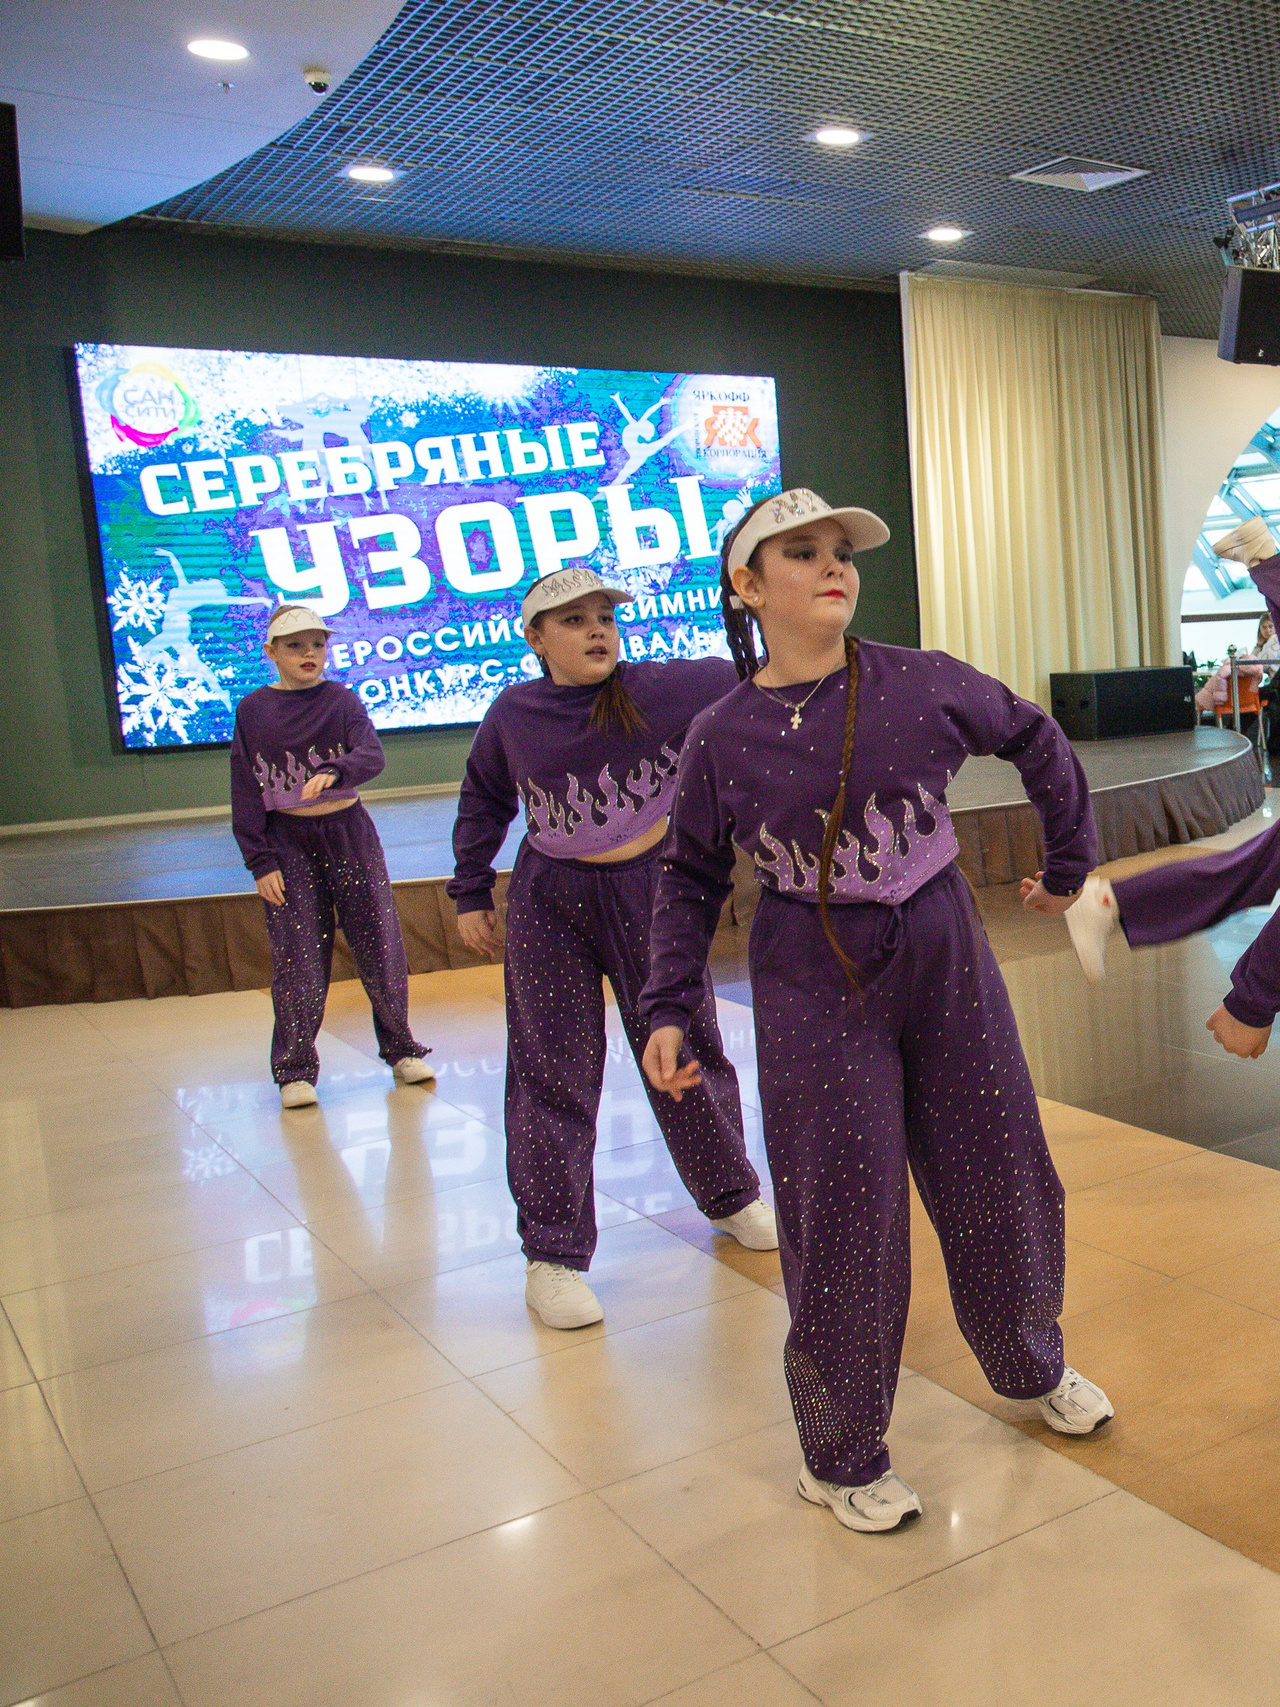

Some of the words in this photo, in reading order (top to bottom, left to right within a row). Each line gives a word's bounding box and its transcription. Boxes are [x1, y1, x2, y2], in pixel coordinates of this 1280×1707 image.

[123, 389, 174, 405] САН
[693, 390, 750, 402] ЯРКОФФ
[125, 406, 176, 420] СИТИ
[703, 447, 767, 459] КОРПОРАЦИЯ
[138, 421, 606, 517] СЕРЕБРЯНЫЕ
[249, 475, 719, 618] УЗОРЫ
[619, 585, 723, 622] ЗИМНИ
